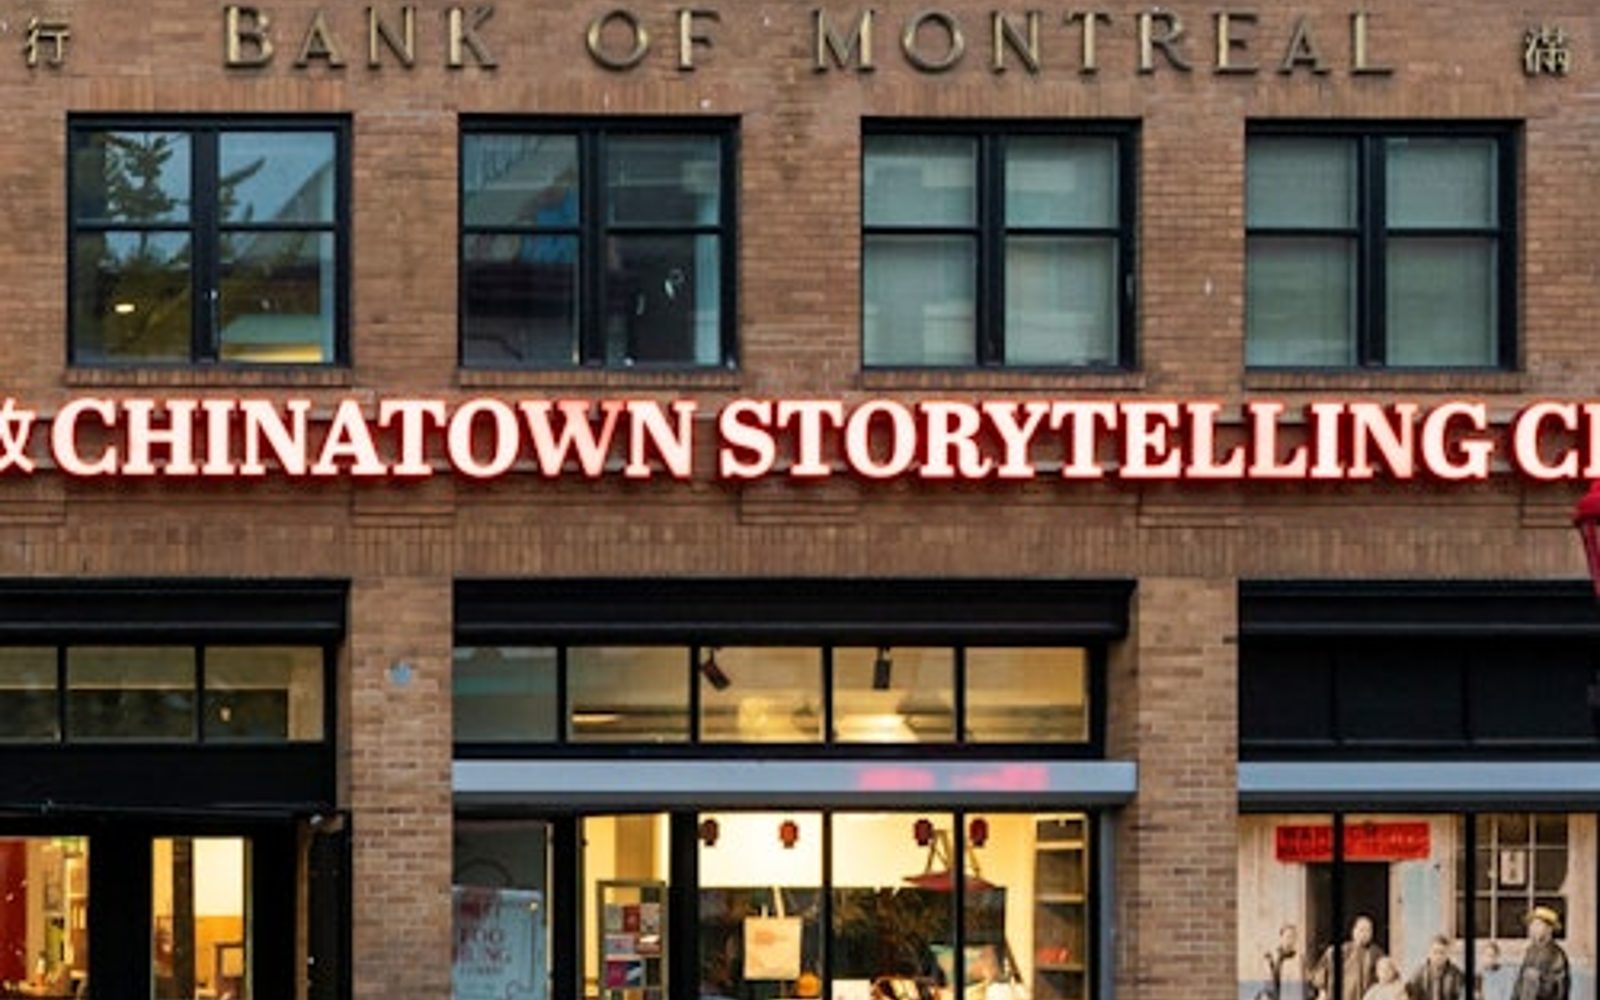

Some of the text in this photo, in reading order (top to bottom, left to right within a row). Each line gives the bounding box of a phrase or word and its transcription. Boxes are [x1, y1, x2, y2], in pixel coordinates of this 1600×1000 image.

[26, 16, 70, 64] 行
[223, 5, 1394, 75] BANK OF MONTREAL
[51, 398, 697, 478] CHINATOWN
[719, 400, 1494, 480] STORYTELLING
[1514, 402, 1600, 480] C
